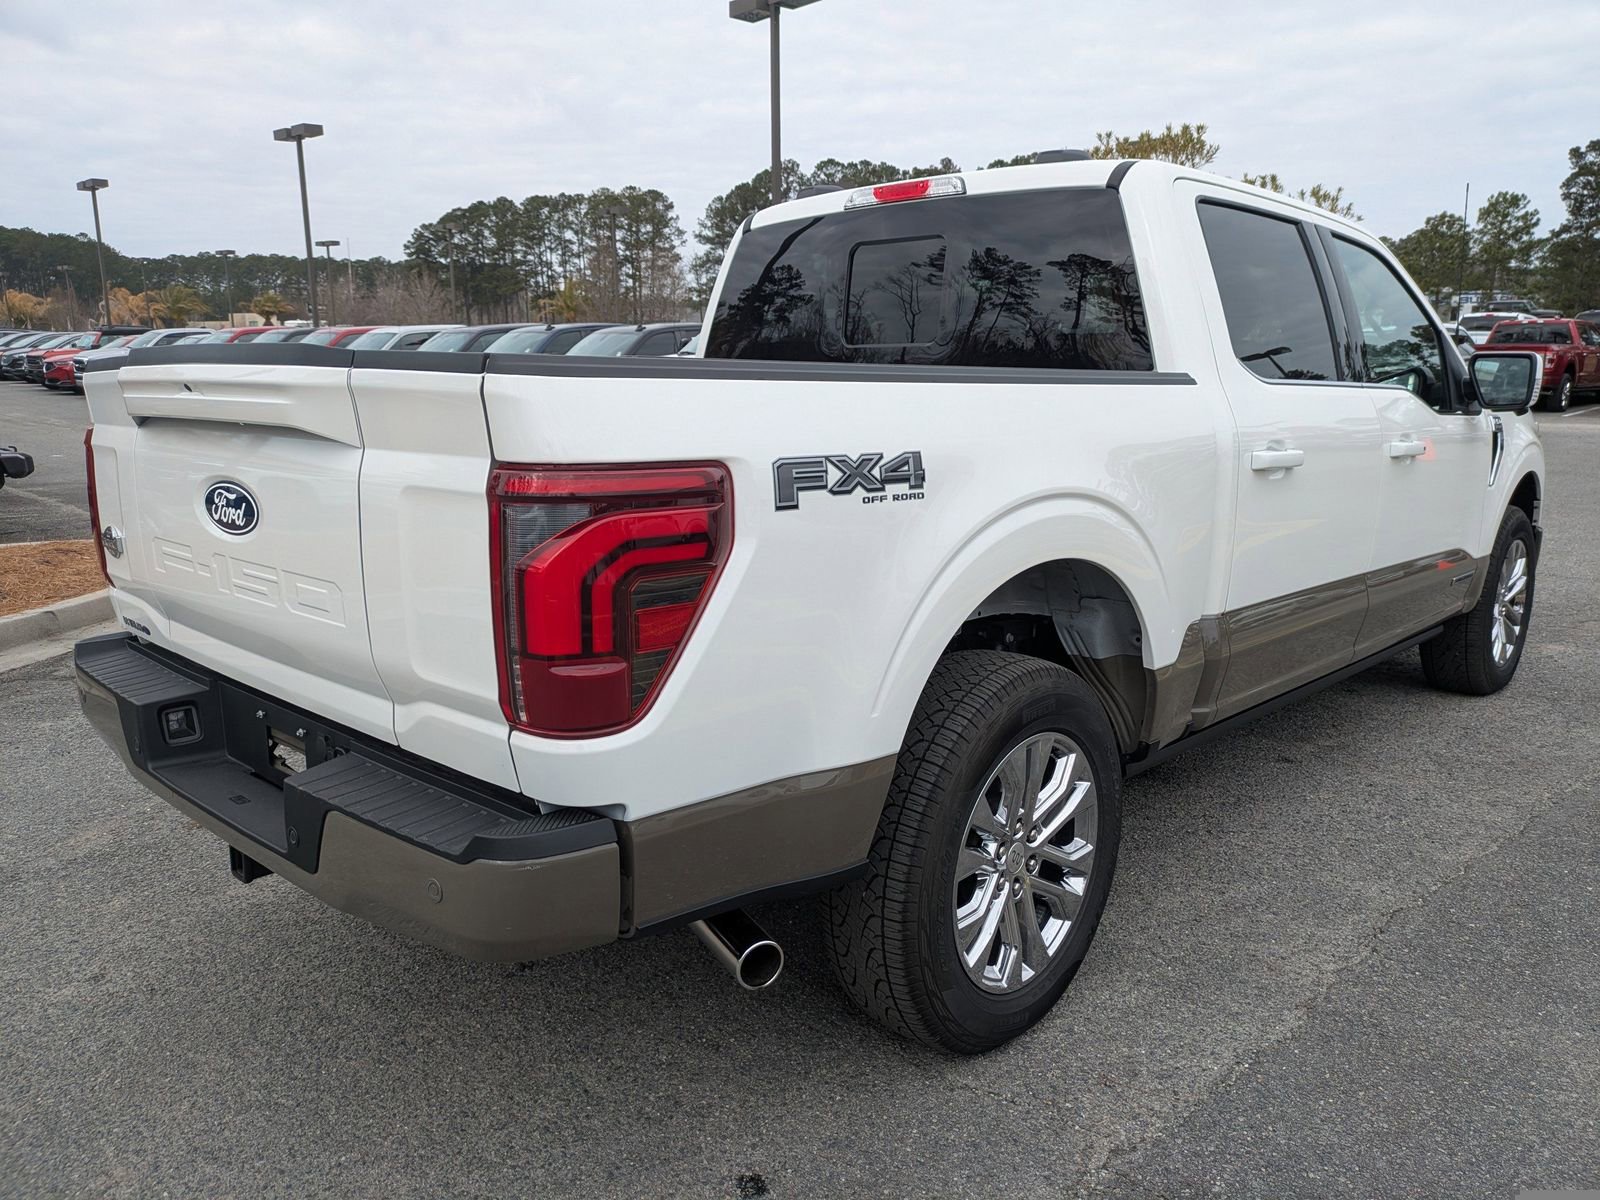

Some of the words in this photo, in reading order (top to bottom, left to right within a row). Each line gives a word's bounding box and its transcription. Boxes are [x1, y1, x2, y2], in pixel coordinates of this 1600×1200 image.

[772, 450, 926, 512] FX4
[862, 494, 888, 505] OFF
[892, 491, 925, 502] ROAD
[211, 488, 246, 527] Ford
[152, 536, 346, 629] F-150
